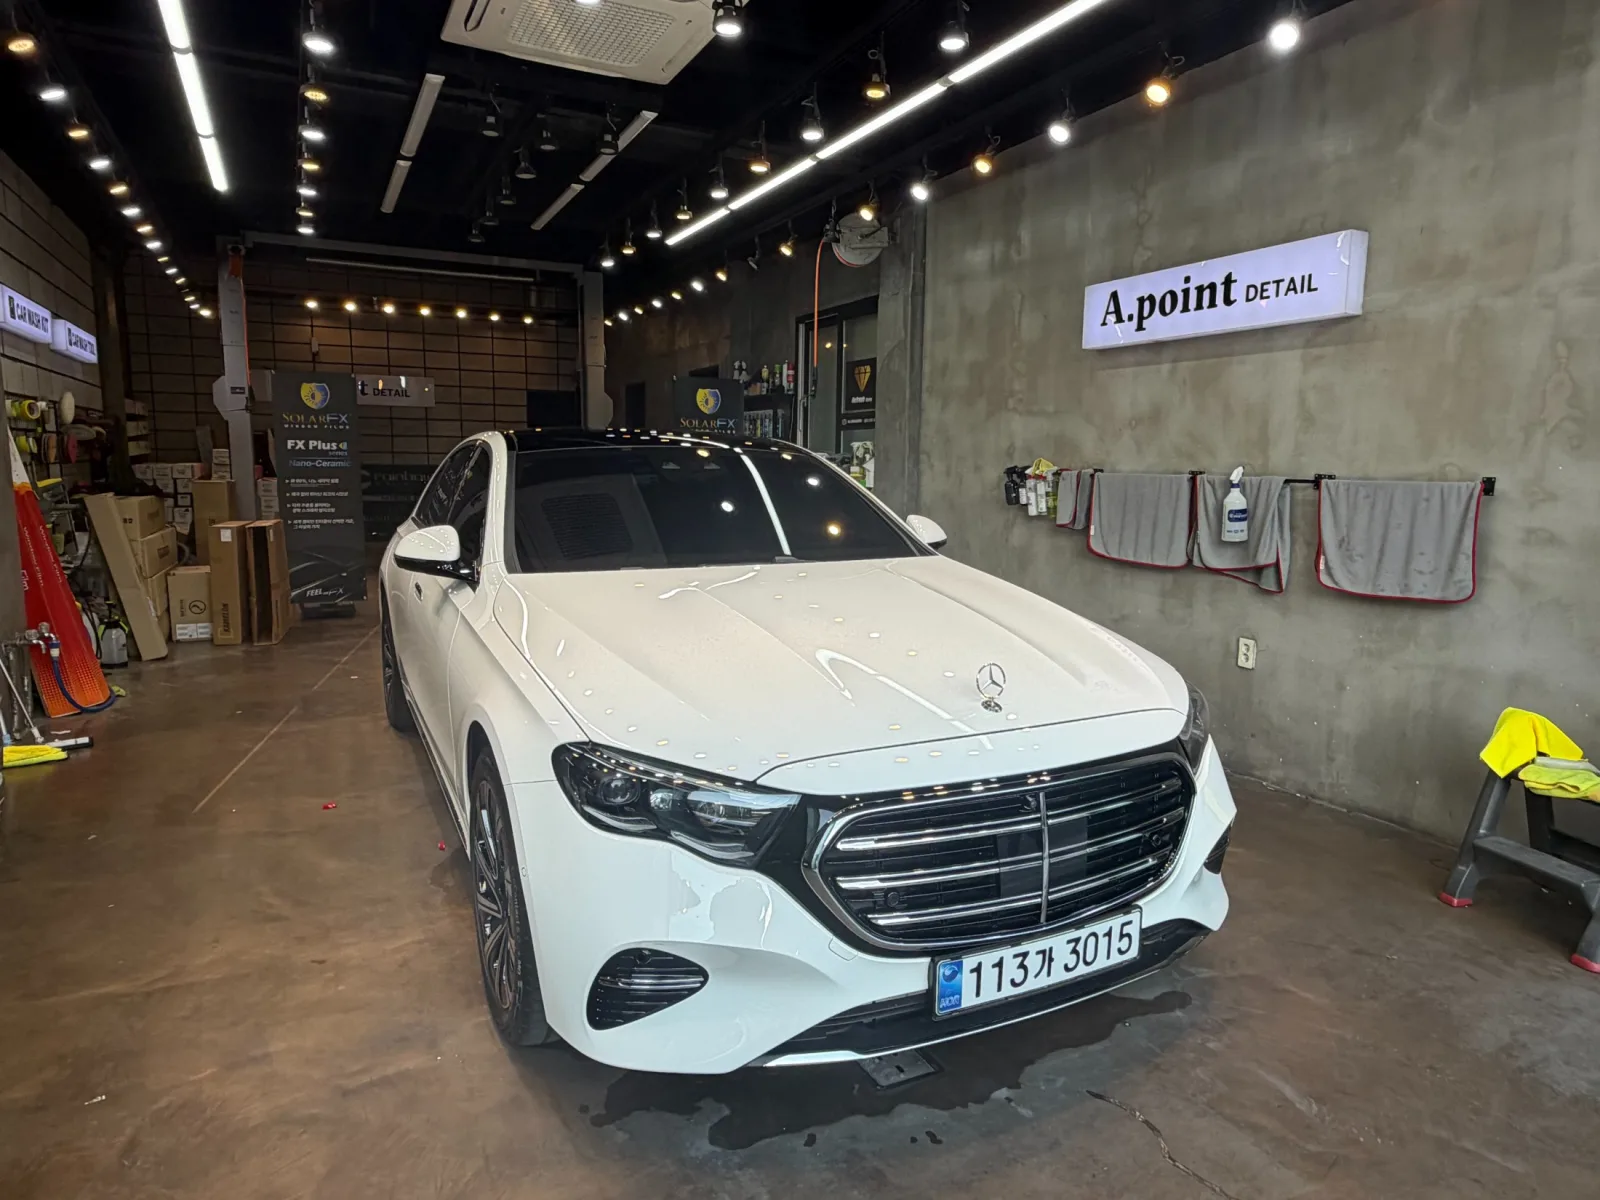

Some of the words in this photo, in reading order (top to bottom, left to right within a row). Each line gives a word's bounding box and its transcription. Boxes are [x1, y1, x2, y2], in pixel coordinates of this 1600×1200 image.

[1100, 271, 1238, 332] A.point
[1244, 273, 1319, 303] DETAIL
[16, 303, 27, 324] CAR
[27, 310, 41, 330] WASH
[373, 387, 411, 398] DETAIL
[287, 439, 306, 450] FX
[308, 440, 338, 450] Plus
[289, 459, 352, 467] Nano-Ceramic
[306, 588, 322, 598] FEEL
[969, 946, 1055, 998] 113가
[1063, 919, 1134, 973] 3015
